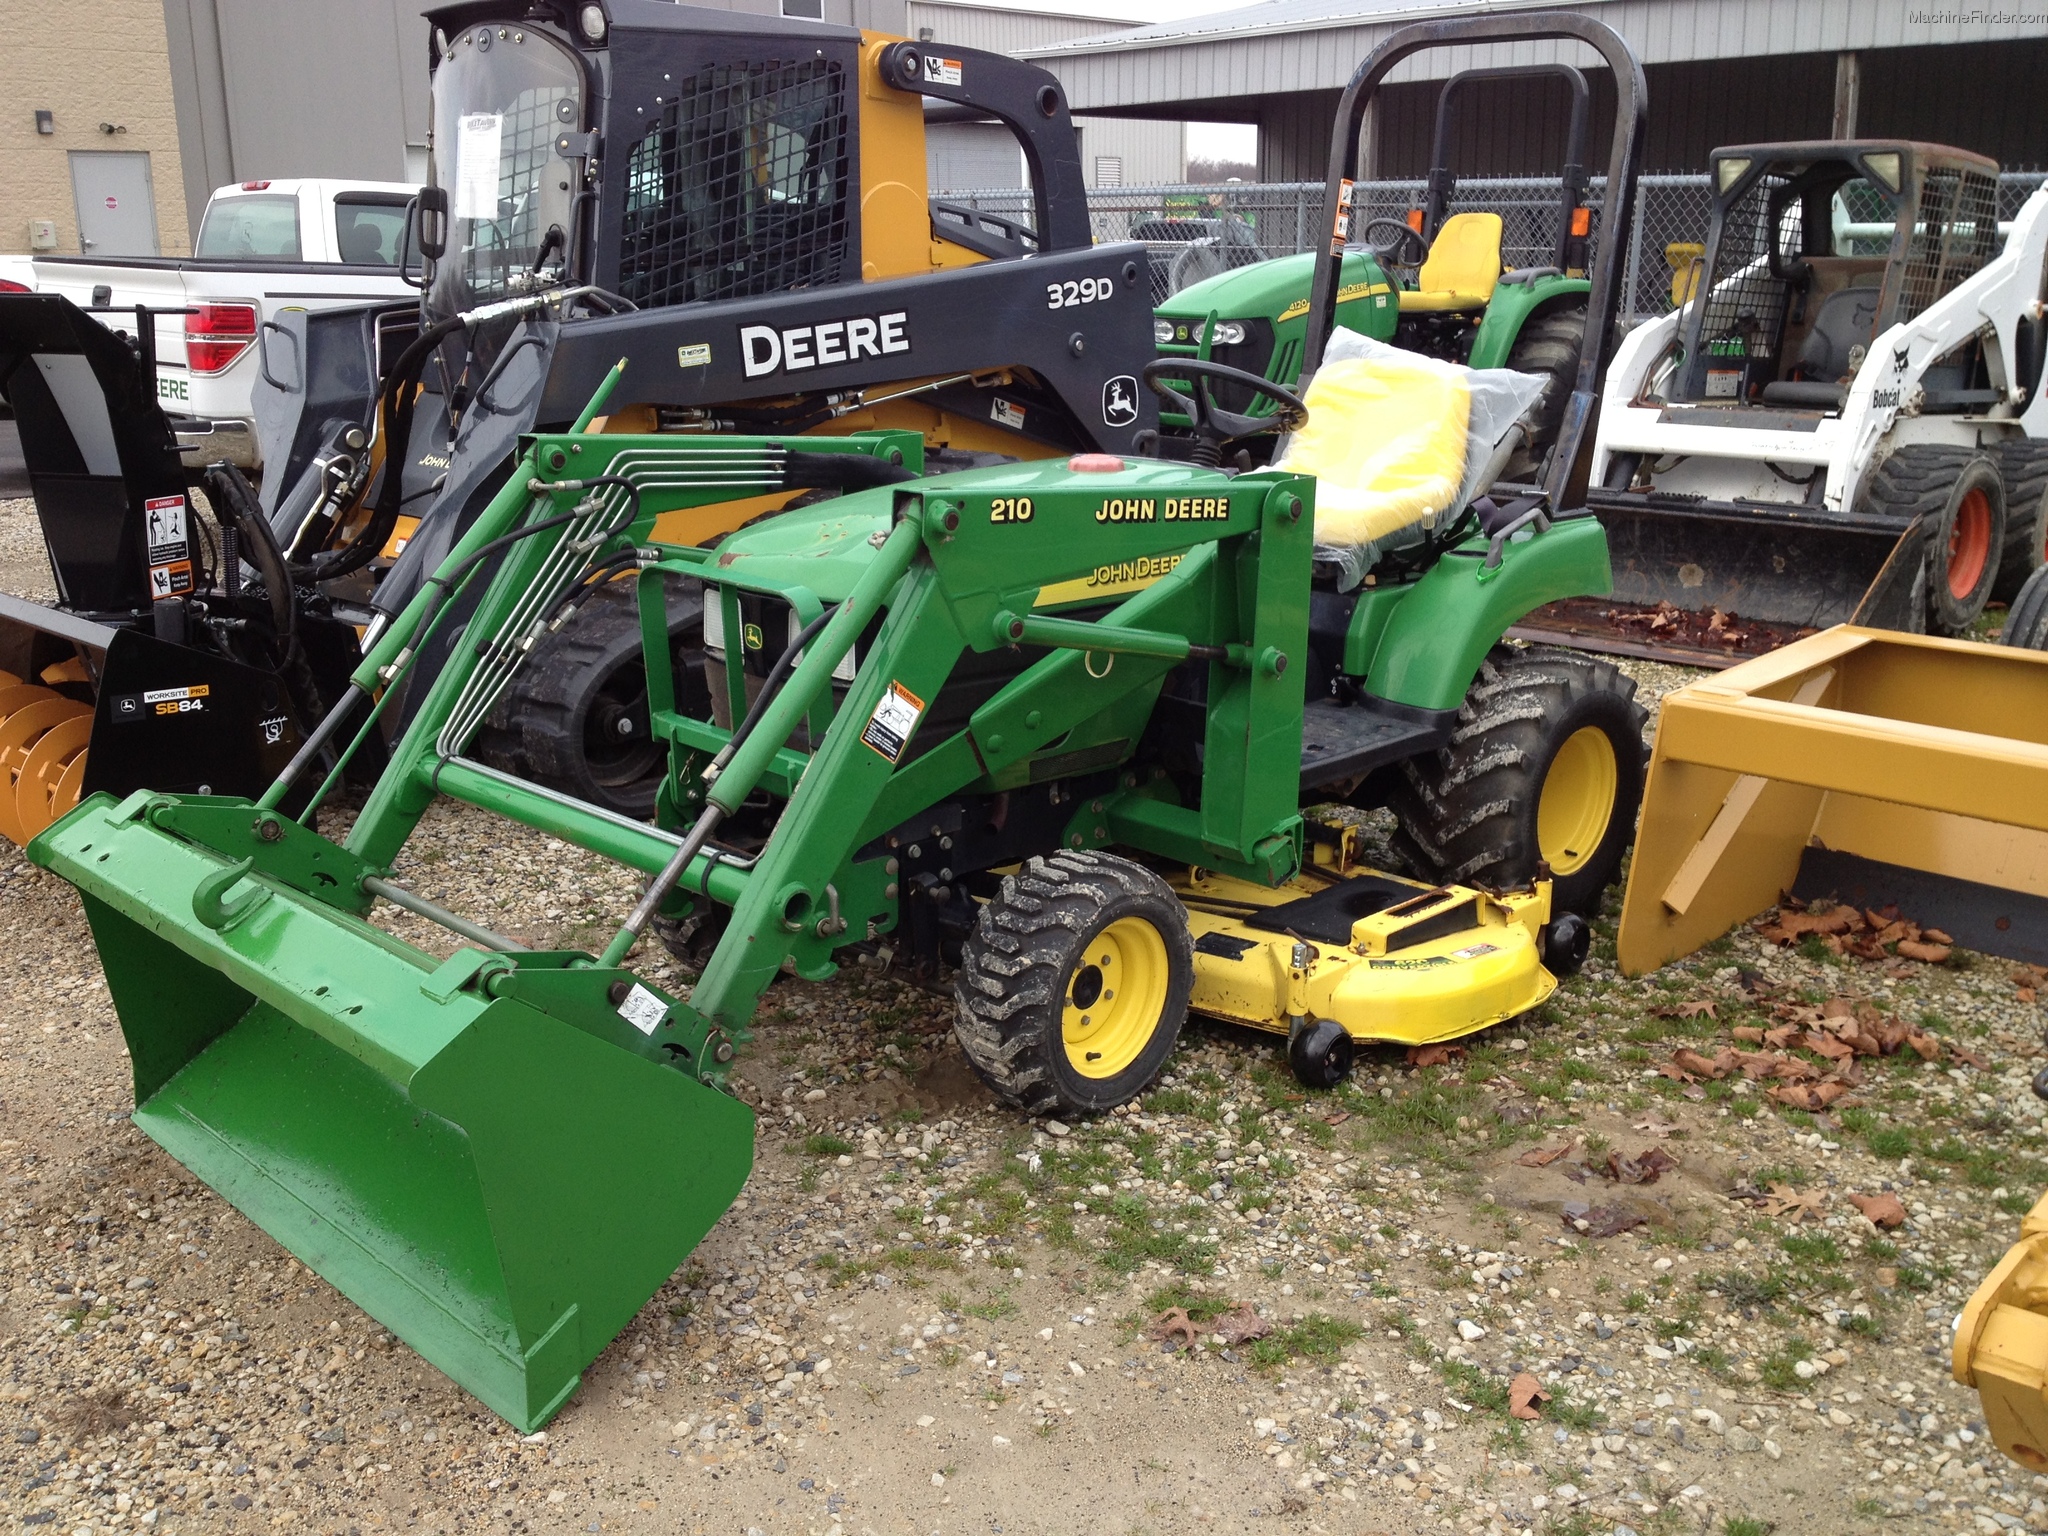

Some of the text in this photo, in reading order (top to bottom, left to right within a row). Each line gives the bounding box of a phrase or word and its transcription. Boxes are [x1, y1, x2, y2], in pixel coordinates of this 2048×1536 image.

[1046, 277, 1114, 310] 329D
[1288, 298, 1308, 312] 4120
[740, 312, 910, 378] DEERE
[1872, 388, 1901, 409] Bobcat
[418, 453, 447, 468] JOHN
[159, 499, 175, 507] DANGER
[990, 497, 1035, 523] 210
[1095, 497, 1229, 524] JOHN DEERE
[1087, 554, 1187, 587] JOHN DEER
[146, 690, 188, 700] WORKSITE
[898, 687, 921, 708] WARNING
[155, 699, 203, 715] SB84
